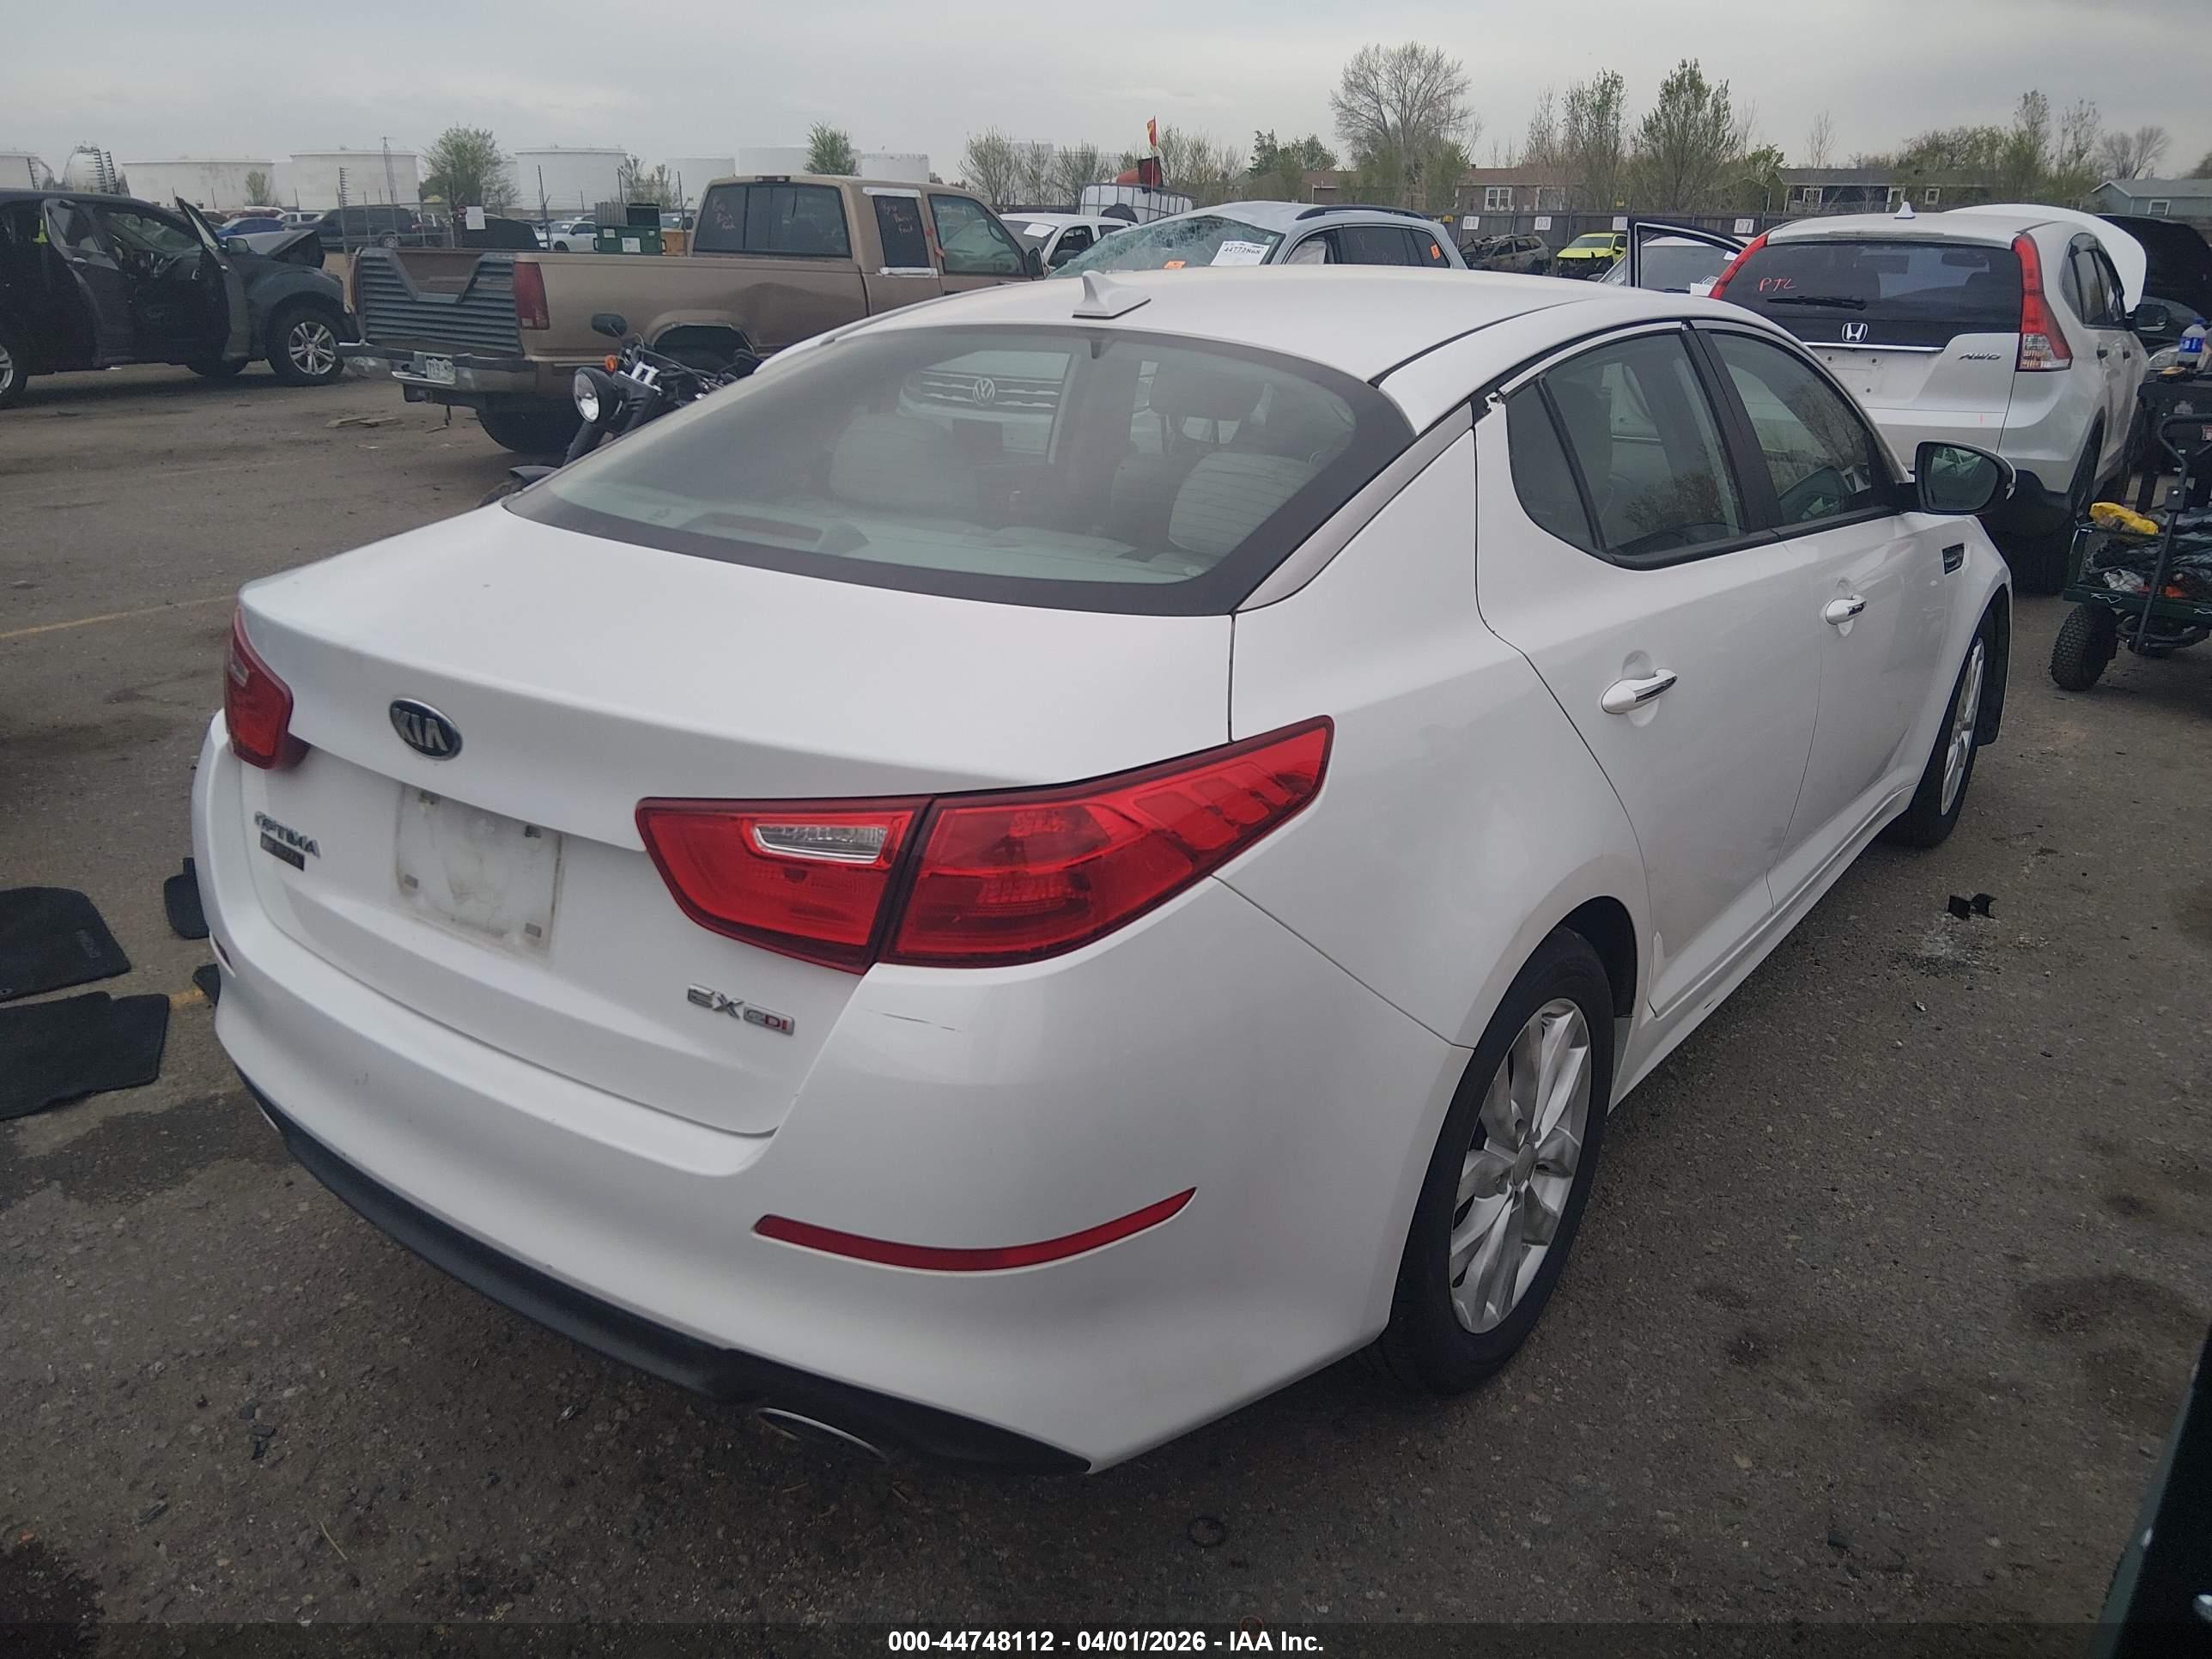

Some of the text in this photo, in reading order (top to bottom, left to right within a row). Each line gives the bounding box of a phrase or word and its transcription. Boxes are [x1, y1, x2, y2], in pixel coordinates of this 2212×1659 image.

[1737, 220, 1752, 234] 07
[1957, 352, 2002, 361] AWD
[391, 707, 449, 752] KIA
[254, 811, 321, 860] OPTIMA
[687, 983, 789, 1032] EX GDI
